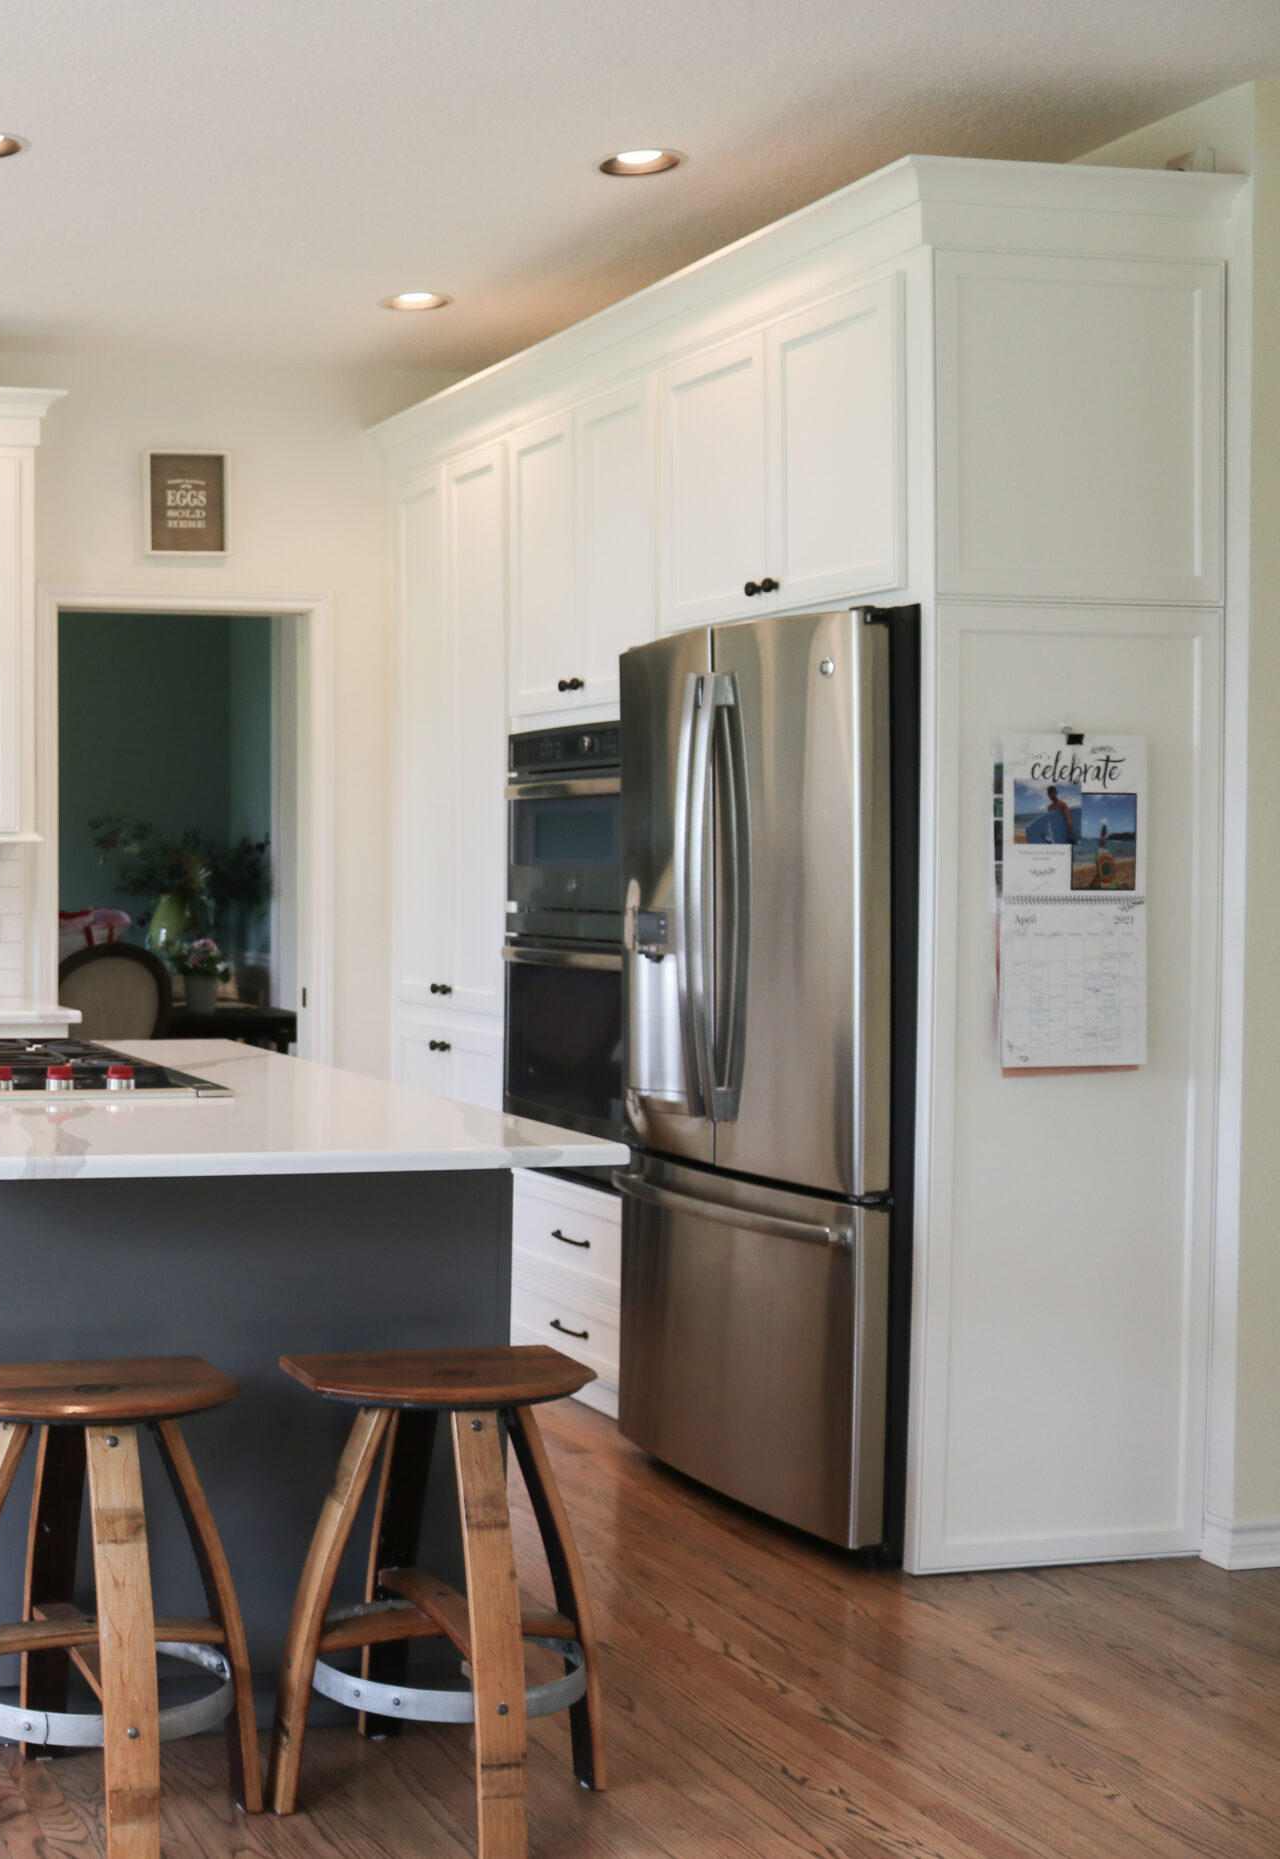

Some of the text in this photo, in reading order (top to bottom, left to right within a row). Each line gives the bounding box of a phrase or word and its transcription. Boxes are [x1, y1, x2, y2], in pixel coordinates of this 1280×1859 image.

[167, 490, 207, 507] EGGS
[167, 509, 206, 518] SOLD
[1031, 750, 1126, 789] celebrate
[1014, 914, 1135, 927] April 2021
